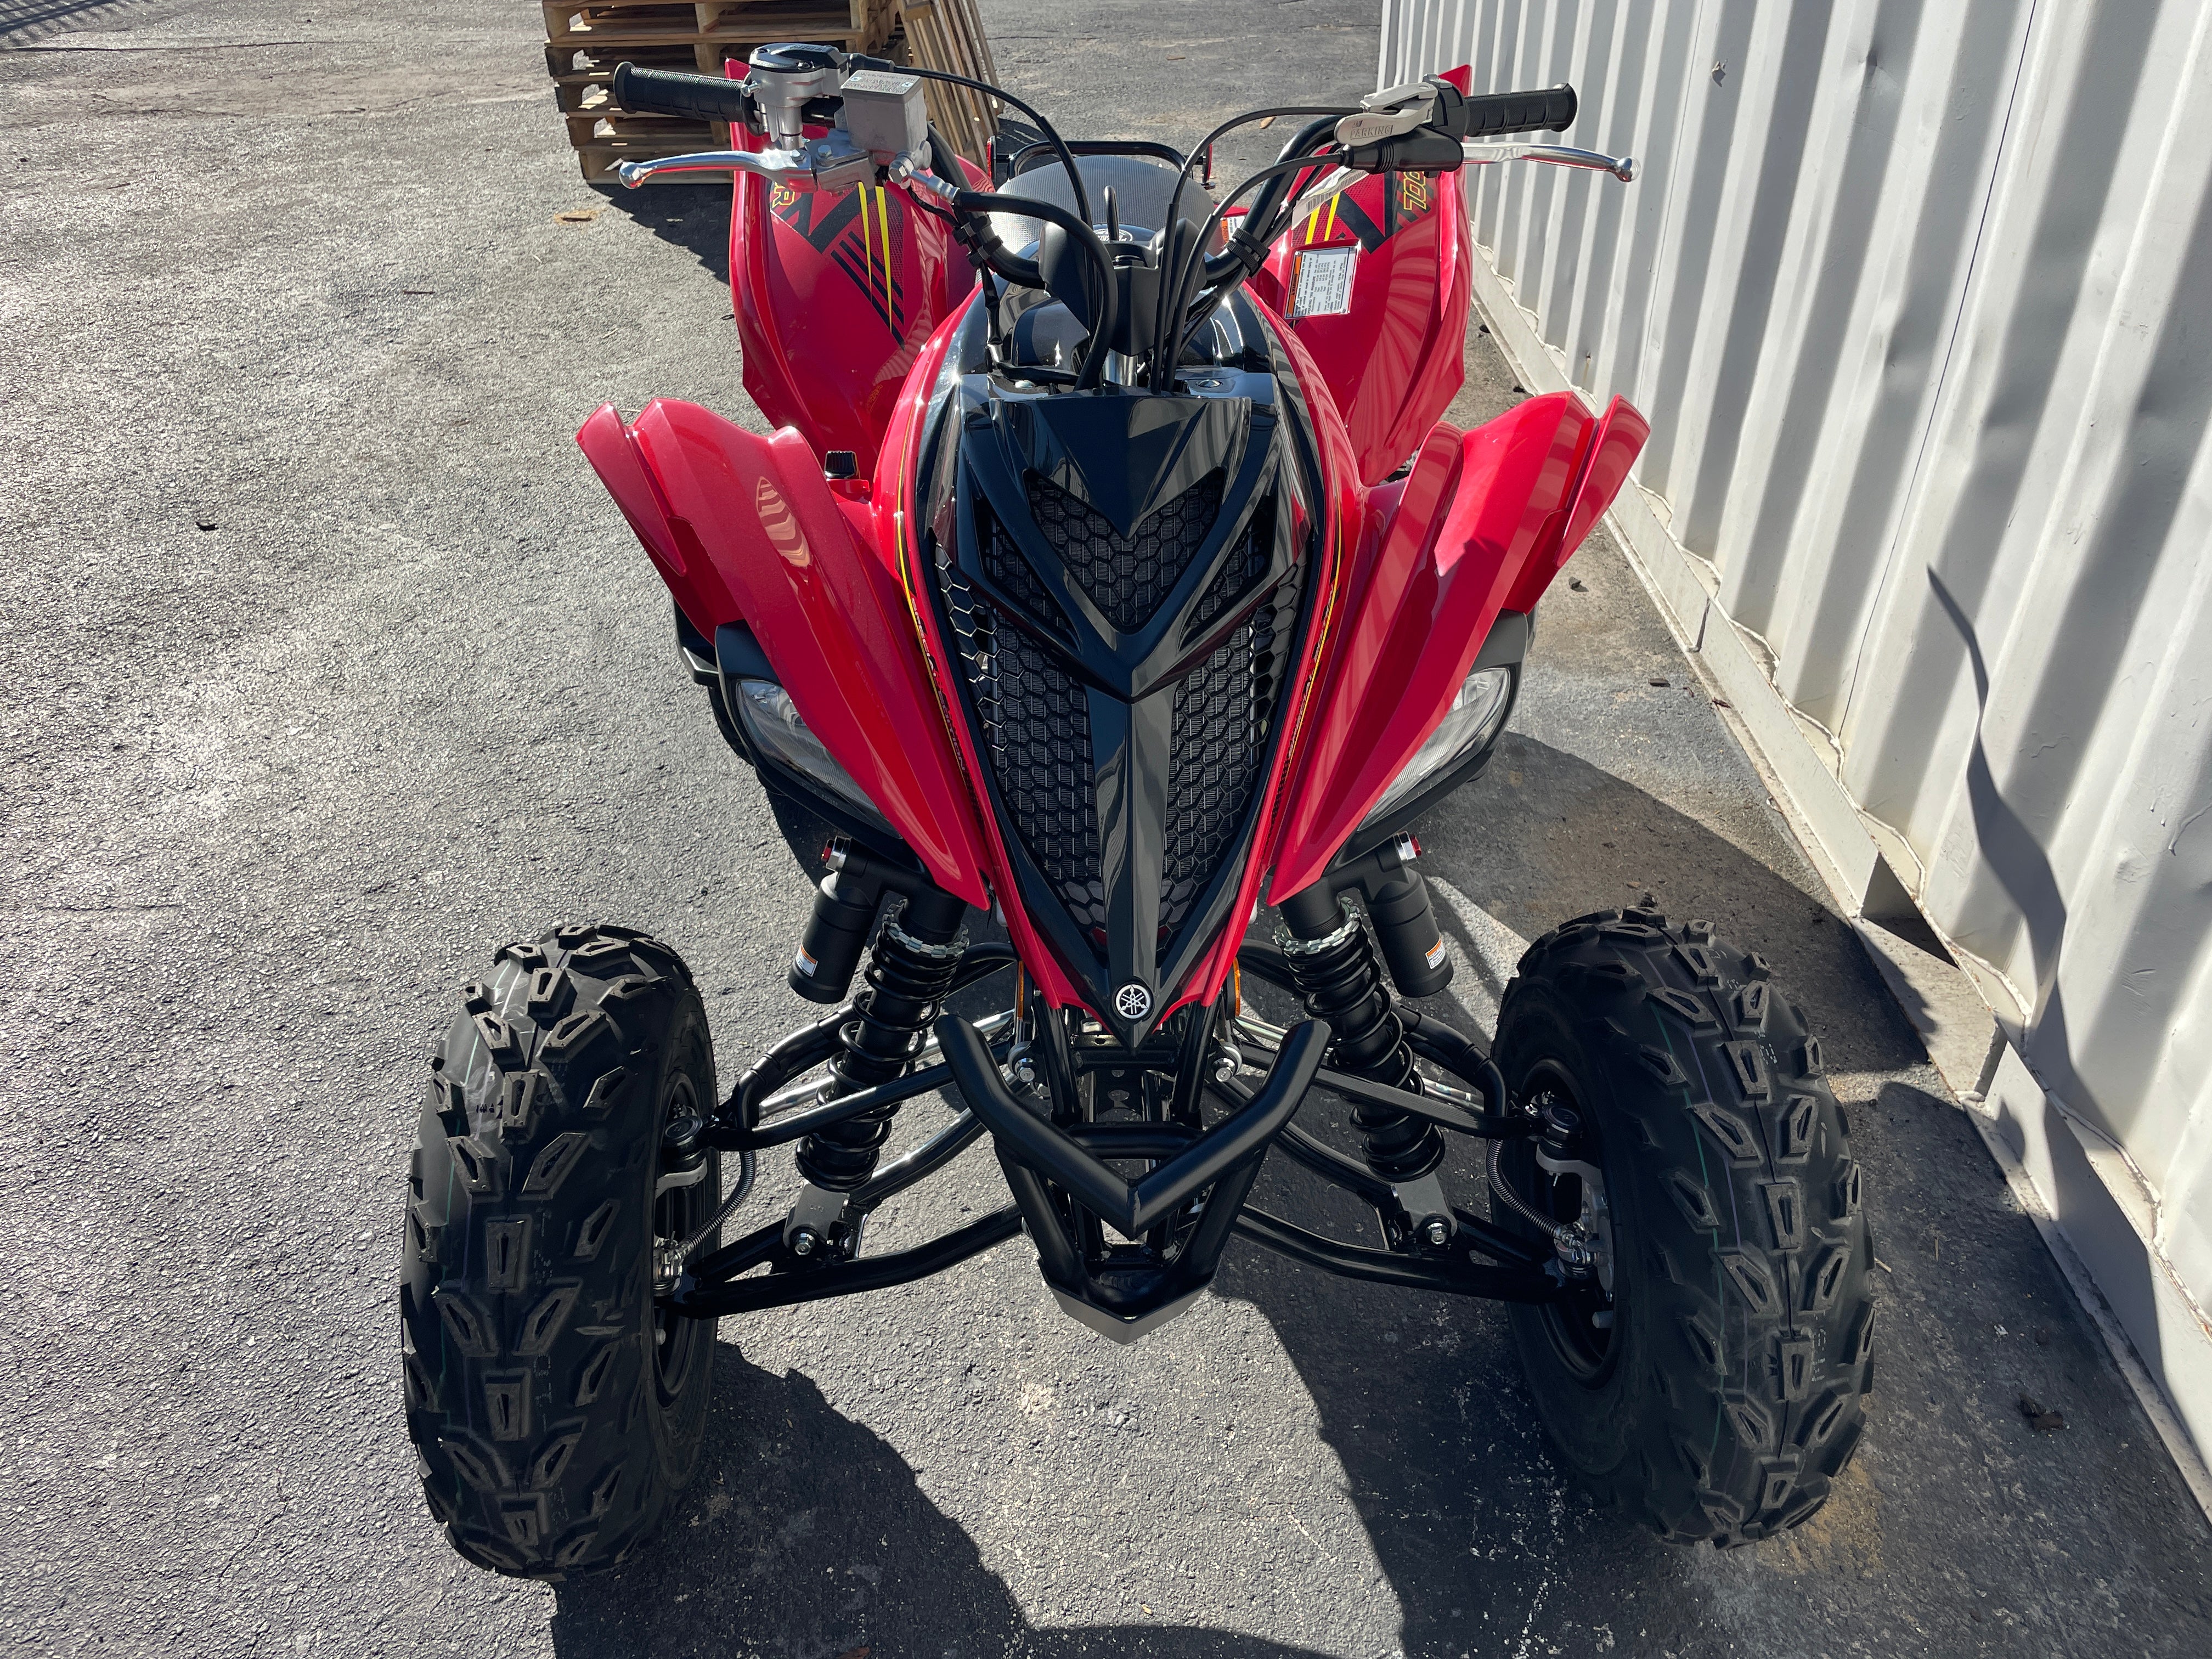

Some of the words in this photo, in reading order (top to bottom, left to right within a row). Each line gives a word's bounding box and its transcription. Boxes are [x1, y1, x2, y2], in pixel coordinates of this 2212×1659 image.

[1350, 125, 1393, 139] PARKING
[772, 182, 795, 208] R
[938, 690, 966, 771] EDITION
